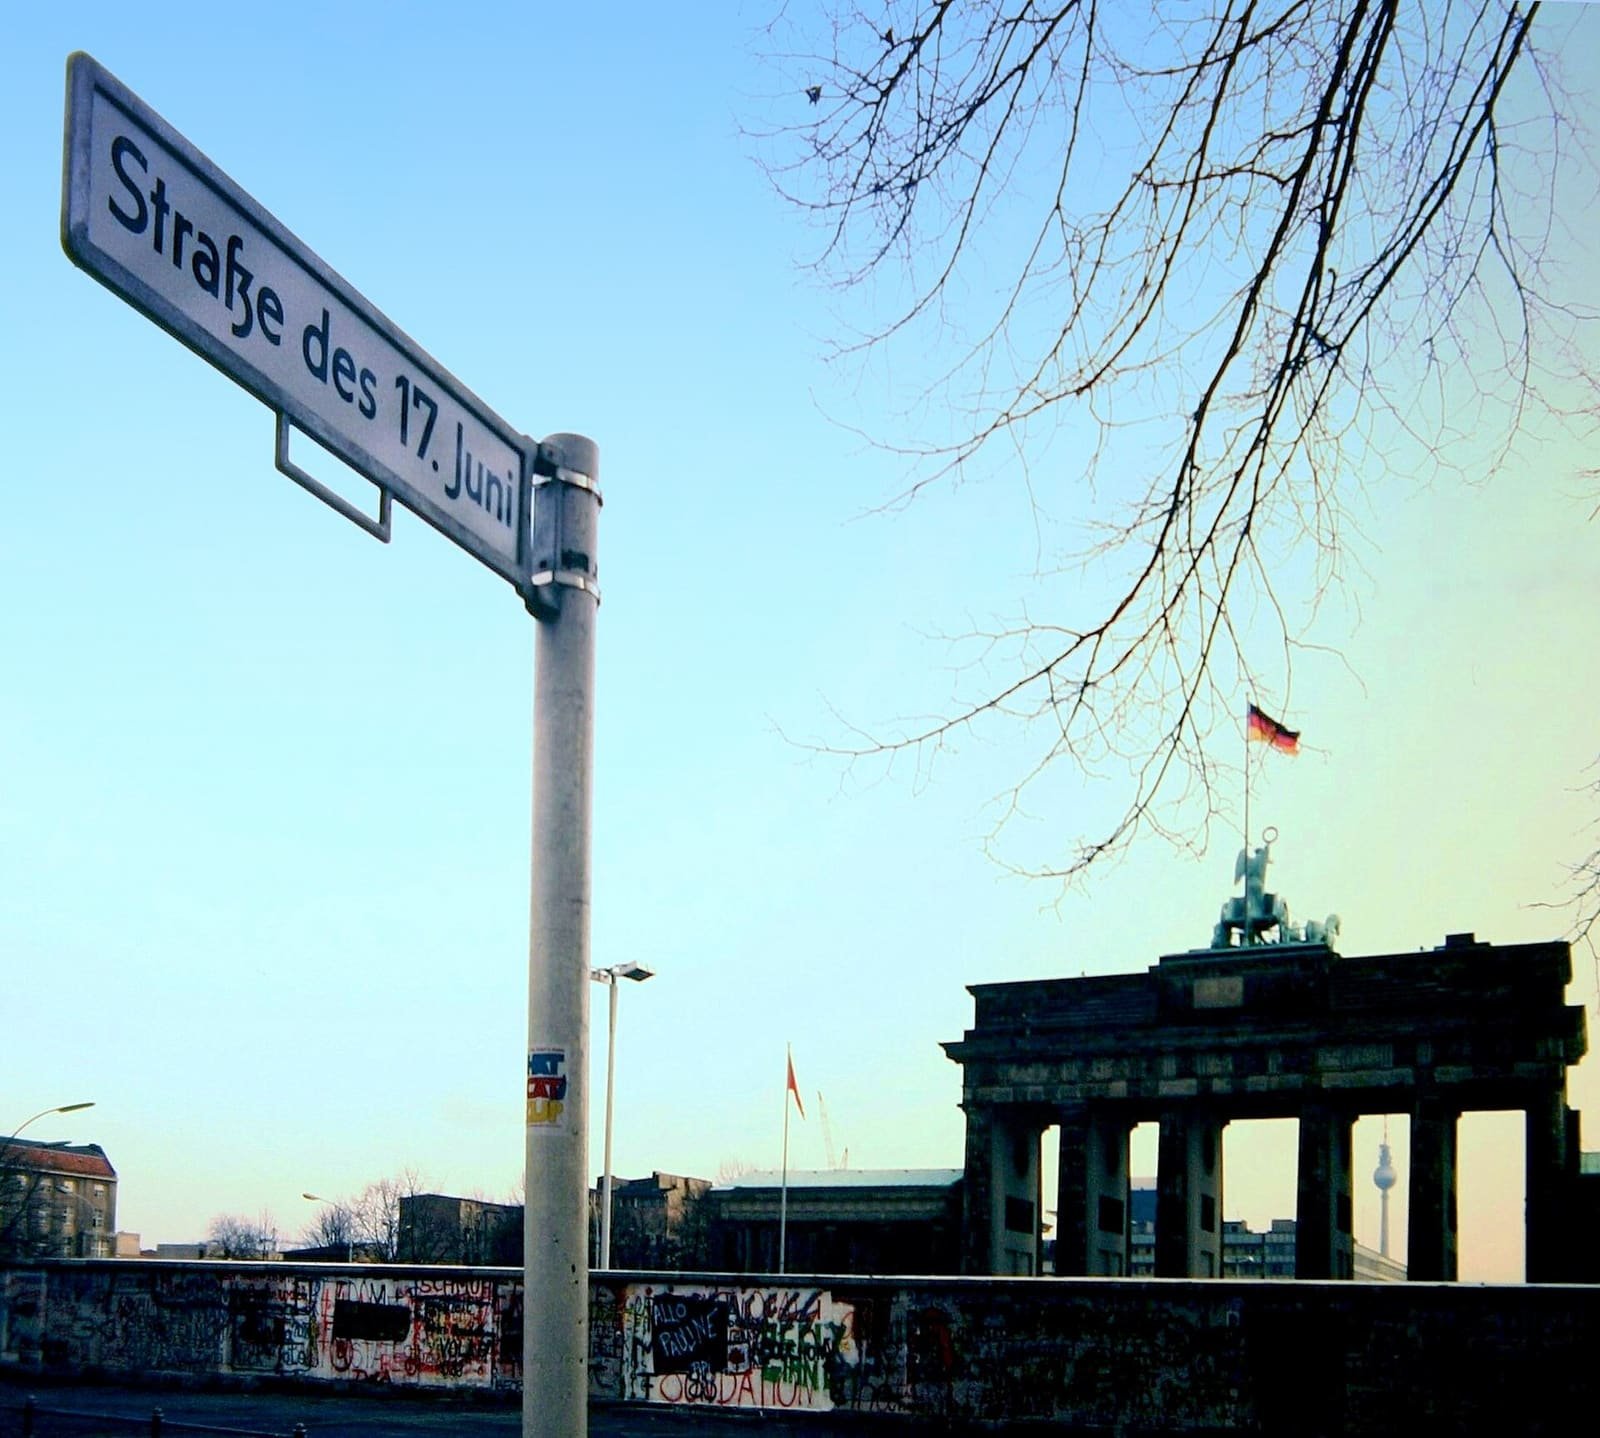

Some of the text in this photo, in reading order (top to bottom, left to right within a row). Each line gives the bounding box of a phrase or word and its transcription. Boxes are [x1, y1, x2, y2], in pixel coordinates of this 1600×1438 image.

[108, 135, 514, 528] Straße des 17. Juni
[653, 1301, 688, 1327] ALLO
